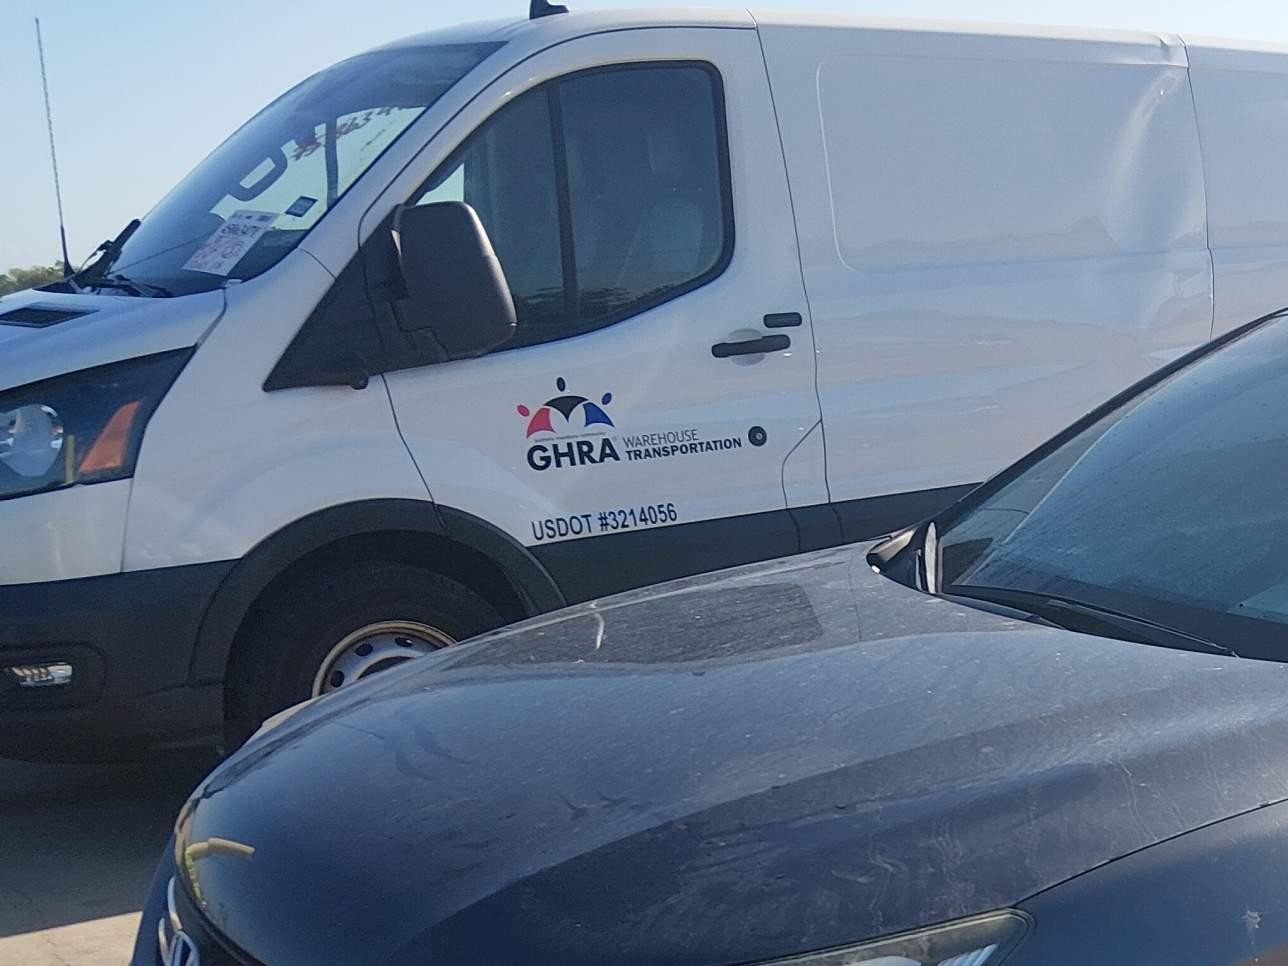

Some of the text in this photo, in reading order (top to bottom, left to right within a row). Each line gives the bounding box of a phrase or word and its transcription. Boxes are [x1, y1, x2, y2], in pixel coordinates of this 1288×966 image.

[623, 428, 699, 449] WAREHOUSE
[626, 437, 743, 461] TRANSPORTATION
[527, 437, 621, 471] GHRA
[531, 502, 678, 541] USDOT #3214056
